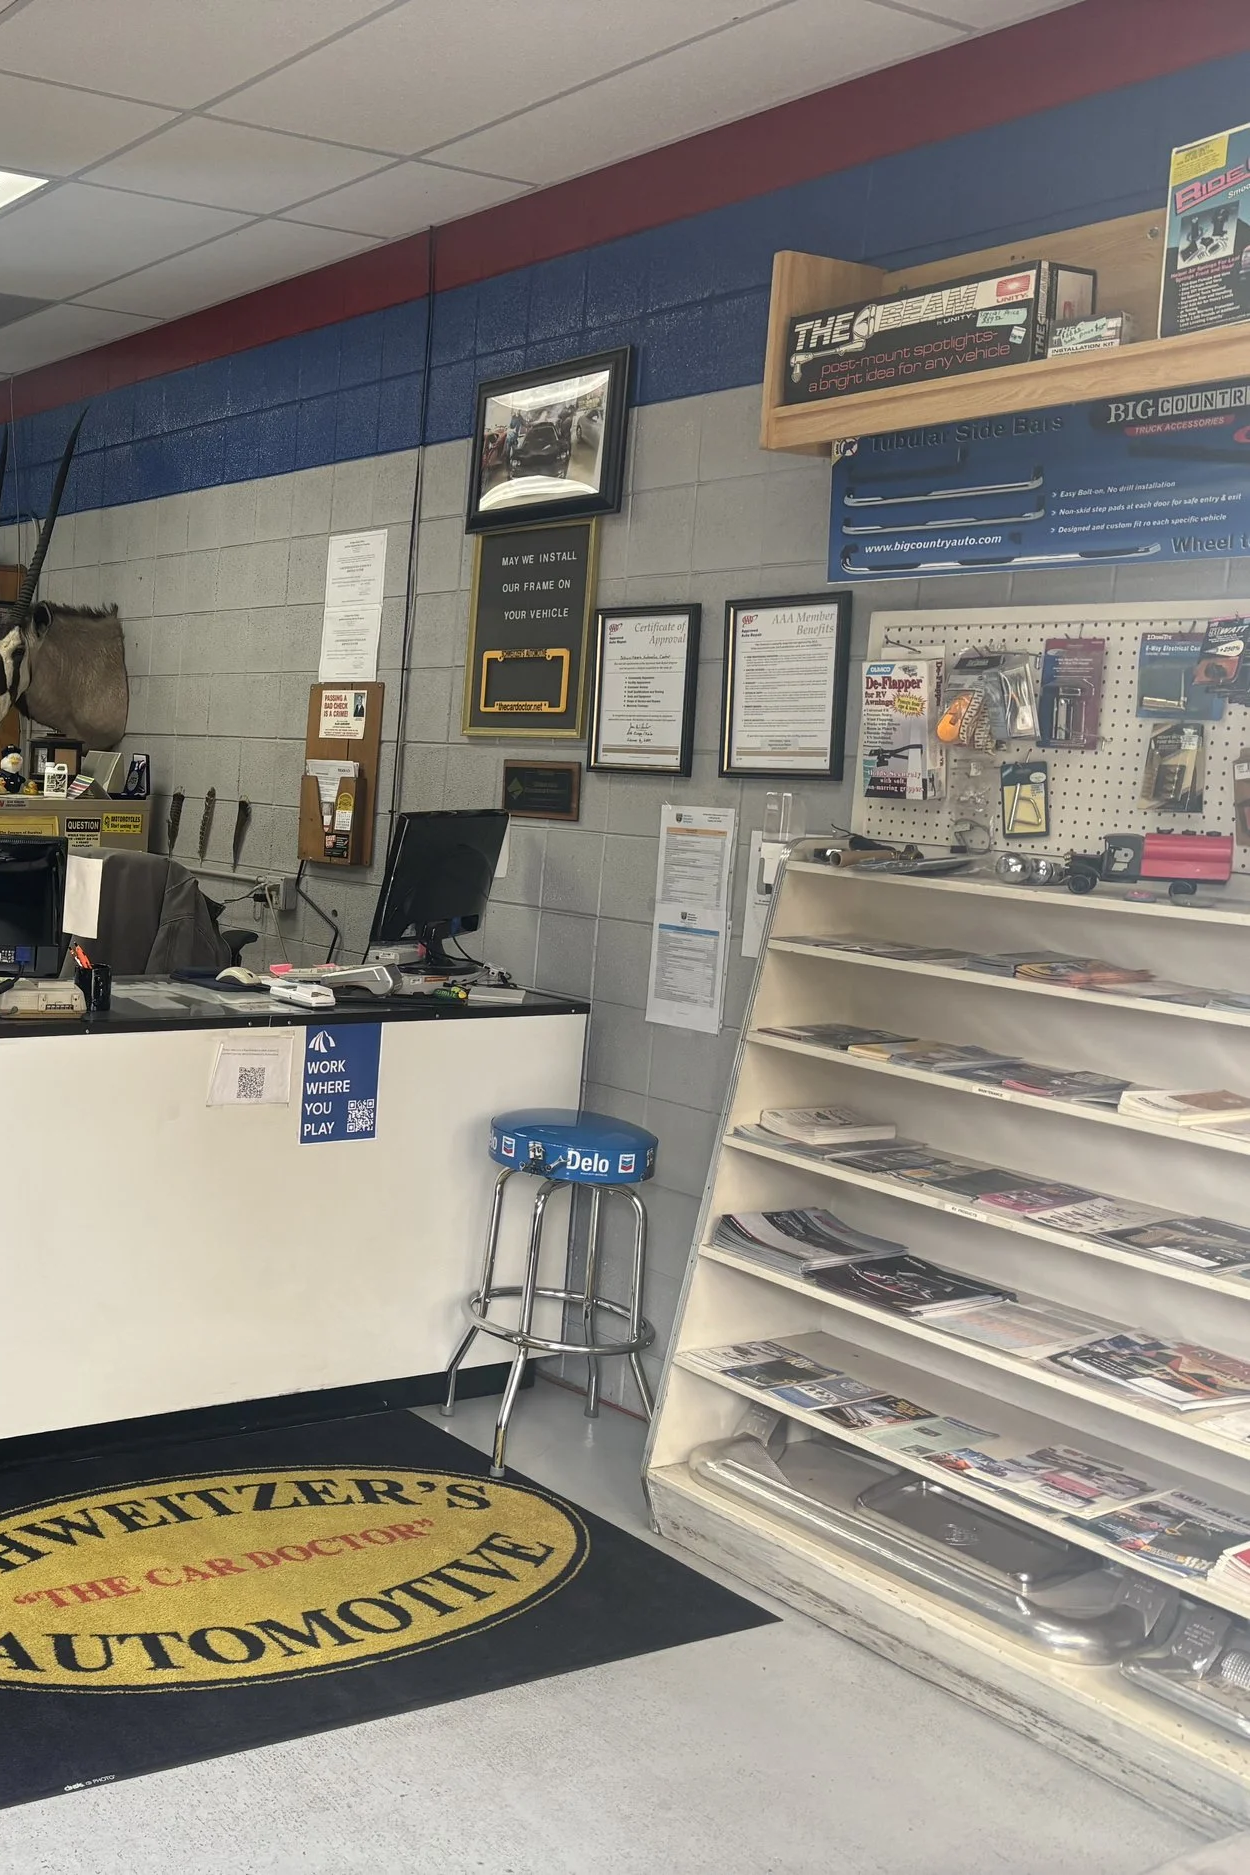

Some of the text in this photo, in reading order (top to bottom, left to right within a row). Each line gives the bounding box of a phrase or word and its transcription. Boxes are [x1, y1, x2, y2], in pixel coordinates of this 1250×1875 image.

[944, 314, 973, 324] UNITY
[795, 312, 855, 350] THE
[1052, 344, 1100, 353] INSTALLATION
[808, 342, 1011, 393] a bright idea for any vehicle
[821, 348, 910, 375] post-mount
[1107, 386, 1250, 423] BIG COUNTR
[956, 422, 1005, 443] Side
[1136, 416, 1225, 434] TRUCK ACCESSORIES
[1060, 490, 1076, 498] Easy
[1135, 480, 1176, 490] installation
[1059, 507, 1091, 516] Non-skid
[1092, 505, 1107, 513] step
[1108, 503, 1125, 512] pads
[1135, 501, 1151, 509] each
[1153, 499, 1170, 507] door
[1171, 498, 1182, 507] for
[1183, 496, 1199, 504] safe
[1200, 495, 1218, 504] entry
[1228, 493, 1241, 501] exit
[1058, 524, 1090, 533] Designed
[1092, 523, 1105, 531] and
[1106, 521, 1132, 529] custom
[1133, 520, 1142, 529] fit
[1152, 518, 1169, 526] each
[1171, 515, 1199, 526] specific
[1200, 513, 1227, 522] vehicle
[865, 533, 1002, 553] www.bigcountryauto.com
[1171, 534, 1234, 554] Wheel
[502, 551, 577, 566] MAY WE INSTALL
[502, 579, 571, 593] OUR FRAME ON
[504, 608, 569, 620] YOUR VEHICLE
[796, 611, 835, 623] Member
[635, 620, 687, 634] Certificate of
[797, 624, 834, 636] Benefits
[649, 634, 686, 646] Approval
[865, 676, 923, 692] De-Flapper
[67, 821, 99, 830] QUESTION
[307, 1060, 346, 1074] WORK
[306, 1080, 351, 1095] WHERE
[304, 1102, 332, 1115] YOU
[303, 1122, 335, 1136] PLAY
[566, 1150, 610, 1173] Delo
[145, 1556, 241, 1589] CAR
